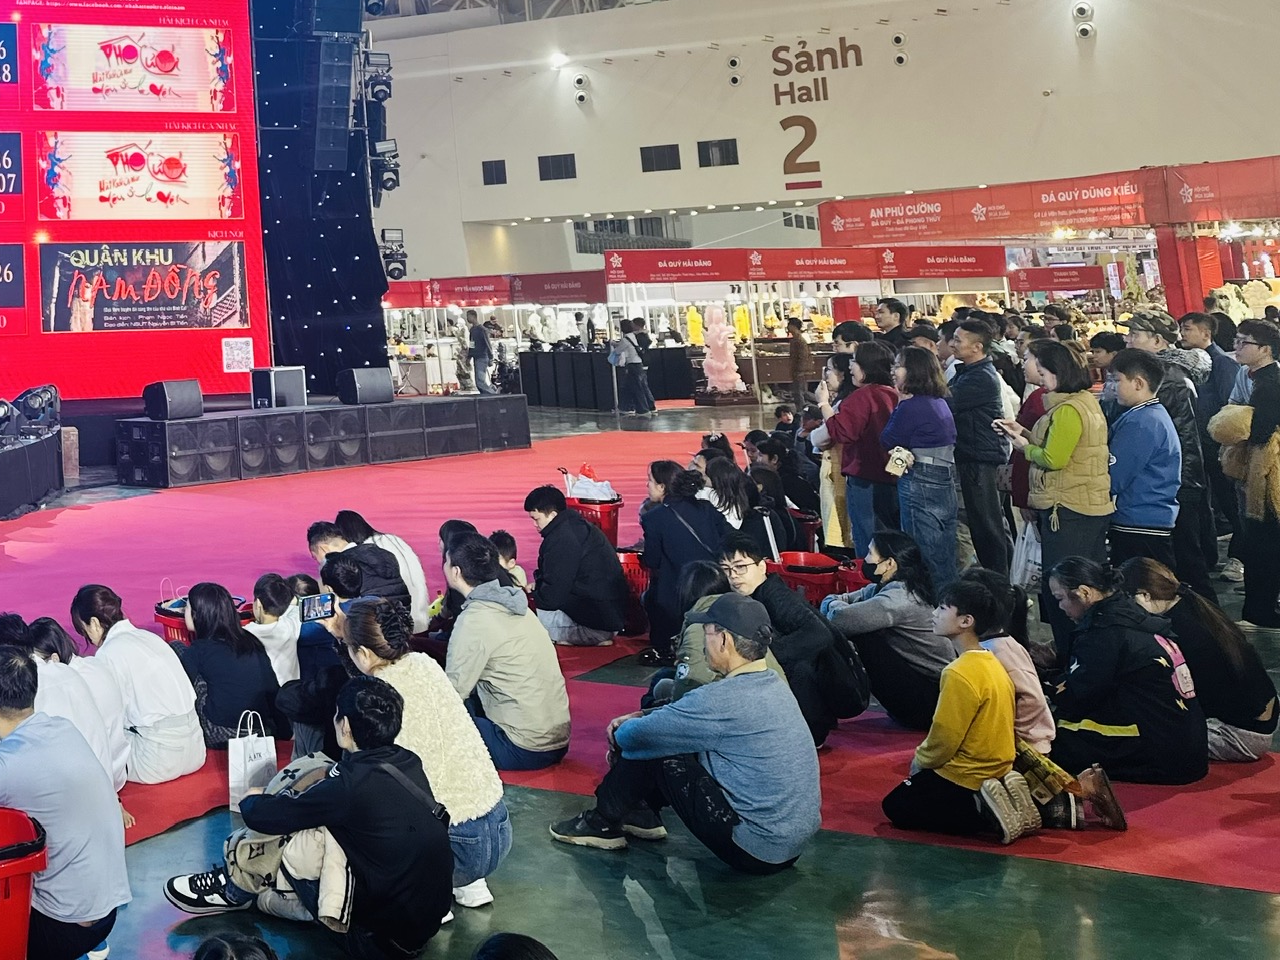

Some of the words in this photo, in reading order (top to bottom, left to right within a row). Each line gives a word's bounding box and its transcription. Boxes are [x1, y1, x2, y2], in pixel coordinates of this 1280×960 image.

[772, 36, 863, 76] Sảnh
[774, 77, 828, 106] Hall
[780, 115, 820, 174] 2
[1042, 190, 1056, 204] ĐÁ
[1058, 188, 1080, 202] QUÝ
[1083, 185, 1112, 200] DŨNG
[870, 208, 883, 220] AN
[885, 204, 904, 218] PHÚ
[906, 202, 941, 216] CƯỜNG
[70, 244, 128, 268] QUÂN
[132, 248, 173, 266] KHU
[658, 260, 668, 268] ĐÁ
[669, 260, 682, 268] QUÝ
[806, 258, 818, 266] QUÝ
[927, 256, 935, 264] ĐÁ
[936, 256, 948, 264] QUÝ
